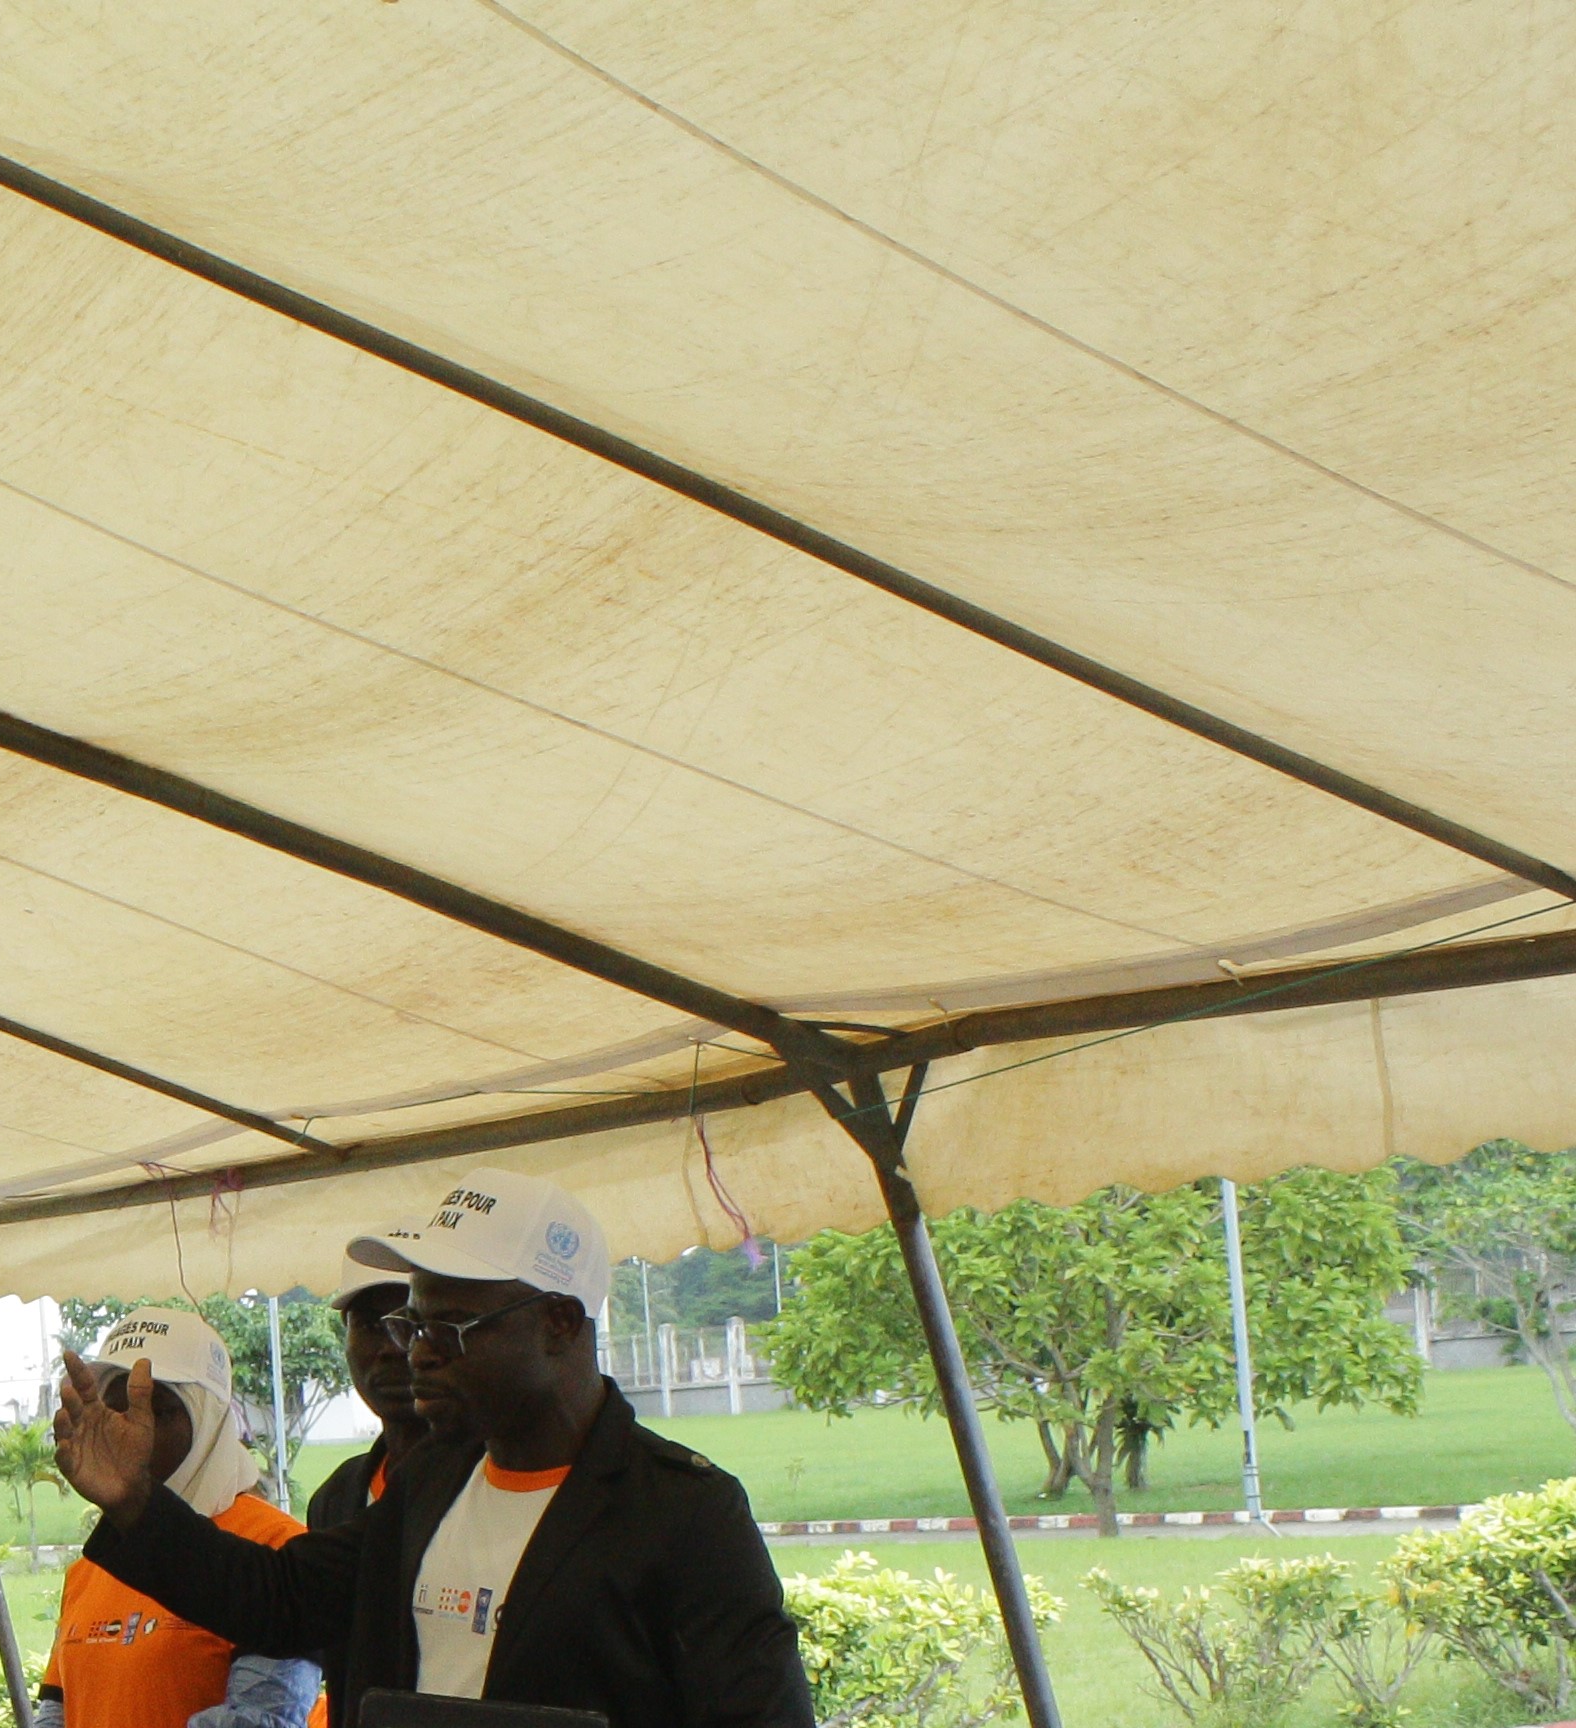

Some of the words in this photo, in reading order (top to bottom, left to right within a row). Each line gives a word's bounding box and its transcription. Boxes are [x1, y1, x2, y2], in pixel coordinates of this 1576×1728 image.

[461, 1190, 498, 1215] POUR
[434, 1211, 464, 1230] PAIX
[139, 1321, 170, 1336] POUR
[109, 1342, 120, 1356] LA
[121, 1336, 146, 1351] PAIX
